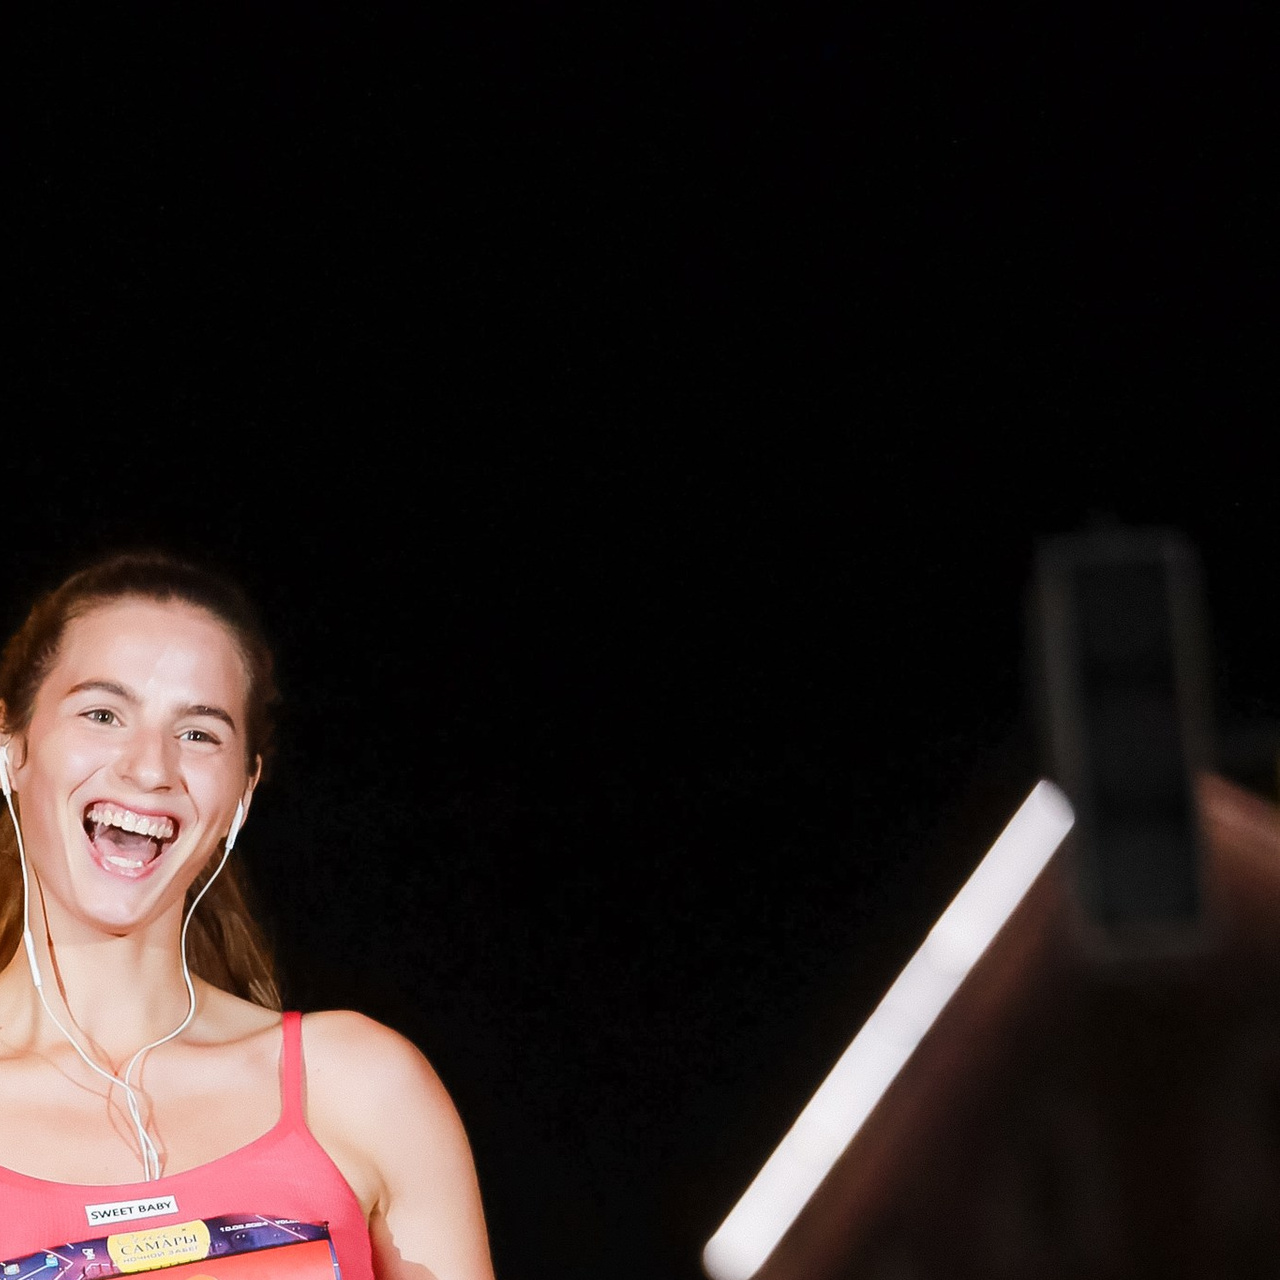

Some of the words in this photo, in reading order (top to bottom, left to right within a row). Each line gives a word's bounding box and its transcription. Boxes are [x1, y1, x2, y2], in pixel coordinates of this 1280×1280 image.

[90, 1206, 134, 1220] SWEET
[138, 1201, 172, 1213] BABY
[120, 1234, 198, 1256] САМАРЫ
[123, 1251, 165, 1263] НОЧНОЙ
